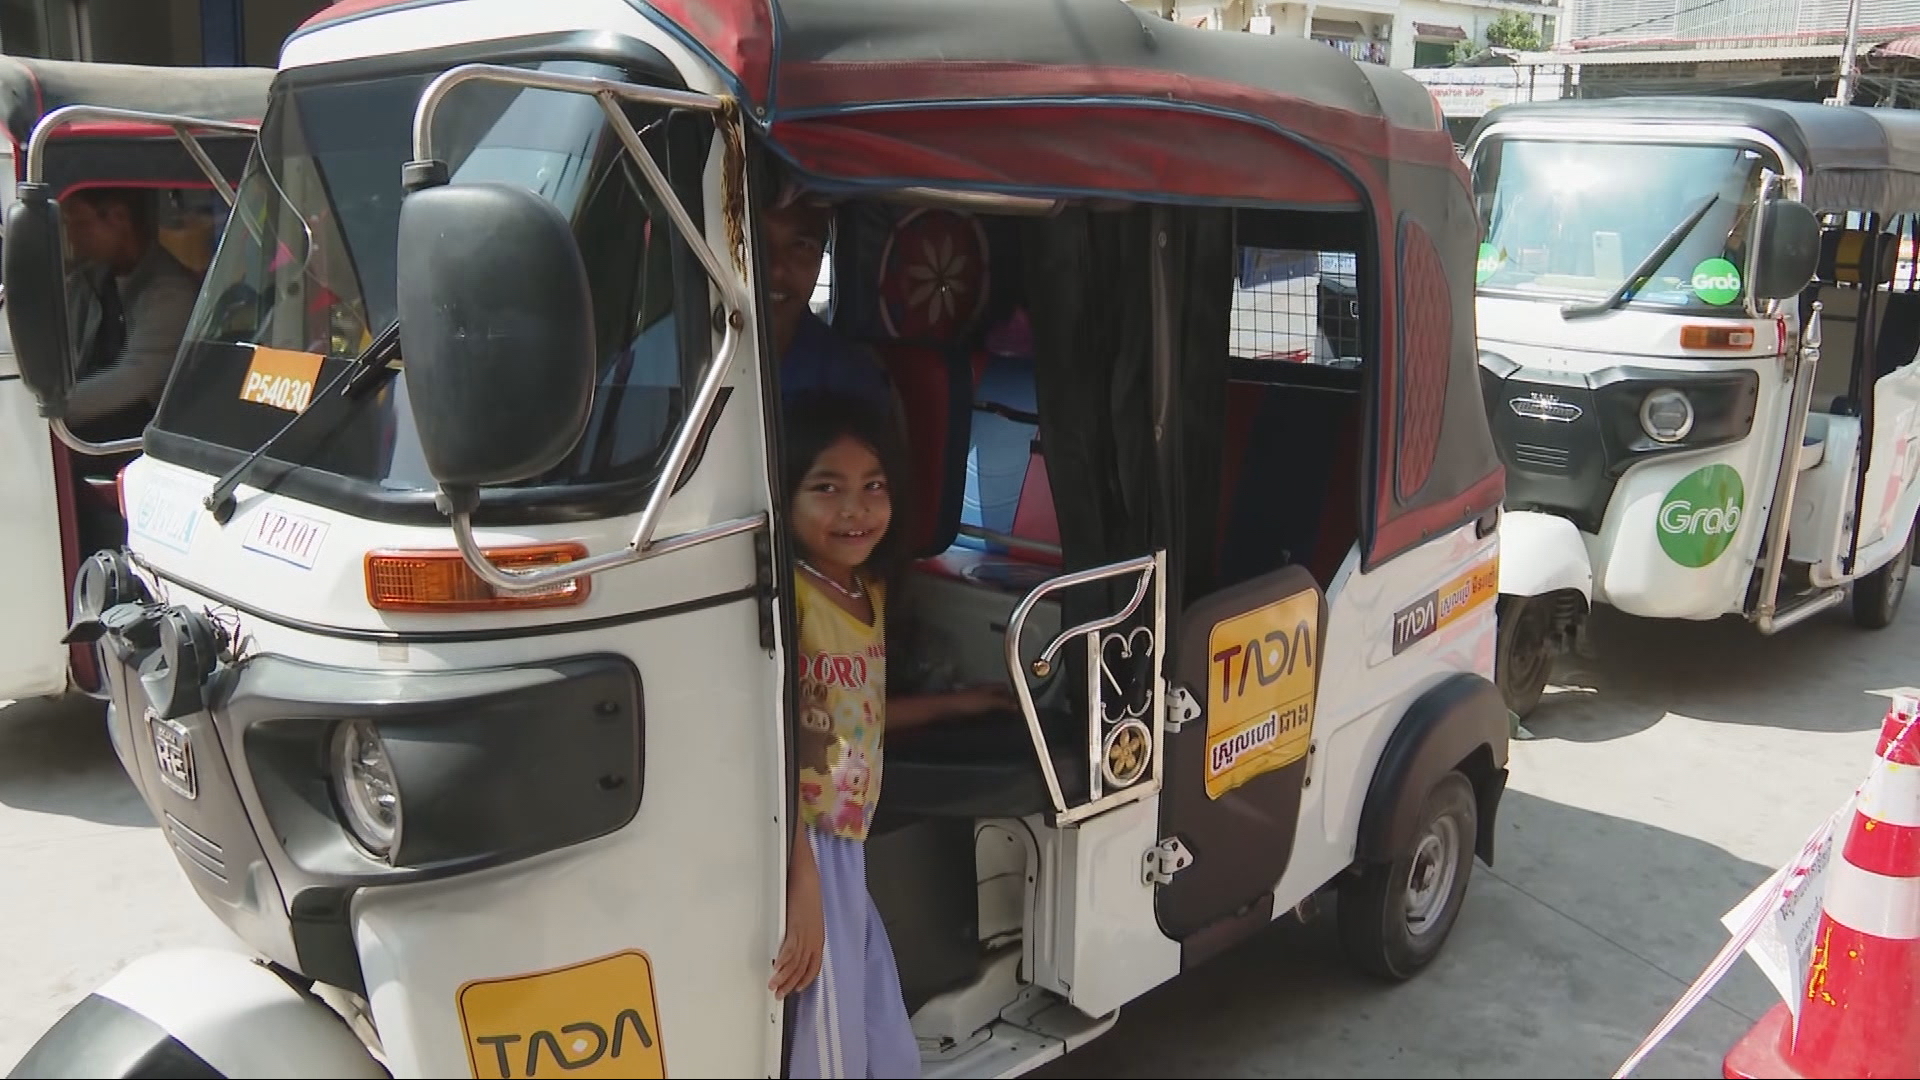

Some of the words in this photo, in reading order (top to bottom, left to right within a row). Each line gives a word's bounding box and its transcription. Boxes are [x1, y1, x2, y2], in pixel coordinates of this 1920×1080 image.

[1692, 271, 1740, 291] Grab
[244, 371, 312, 416] P54030
[1660, 497, 1740, 535] Grab
[1398, 600, 1434, 644] TADA
[1213, 619, 1312, 703] TADA
[476, 1008, 653, 1079] TADA
